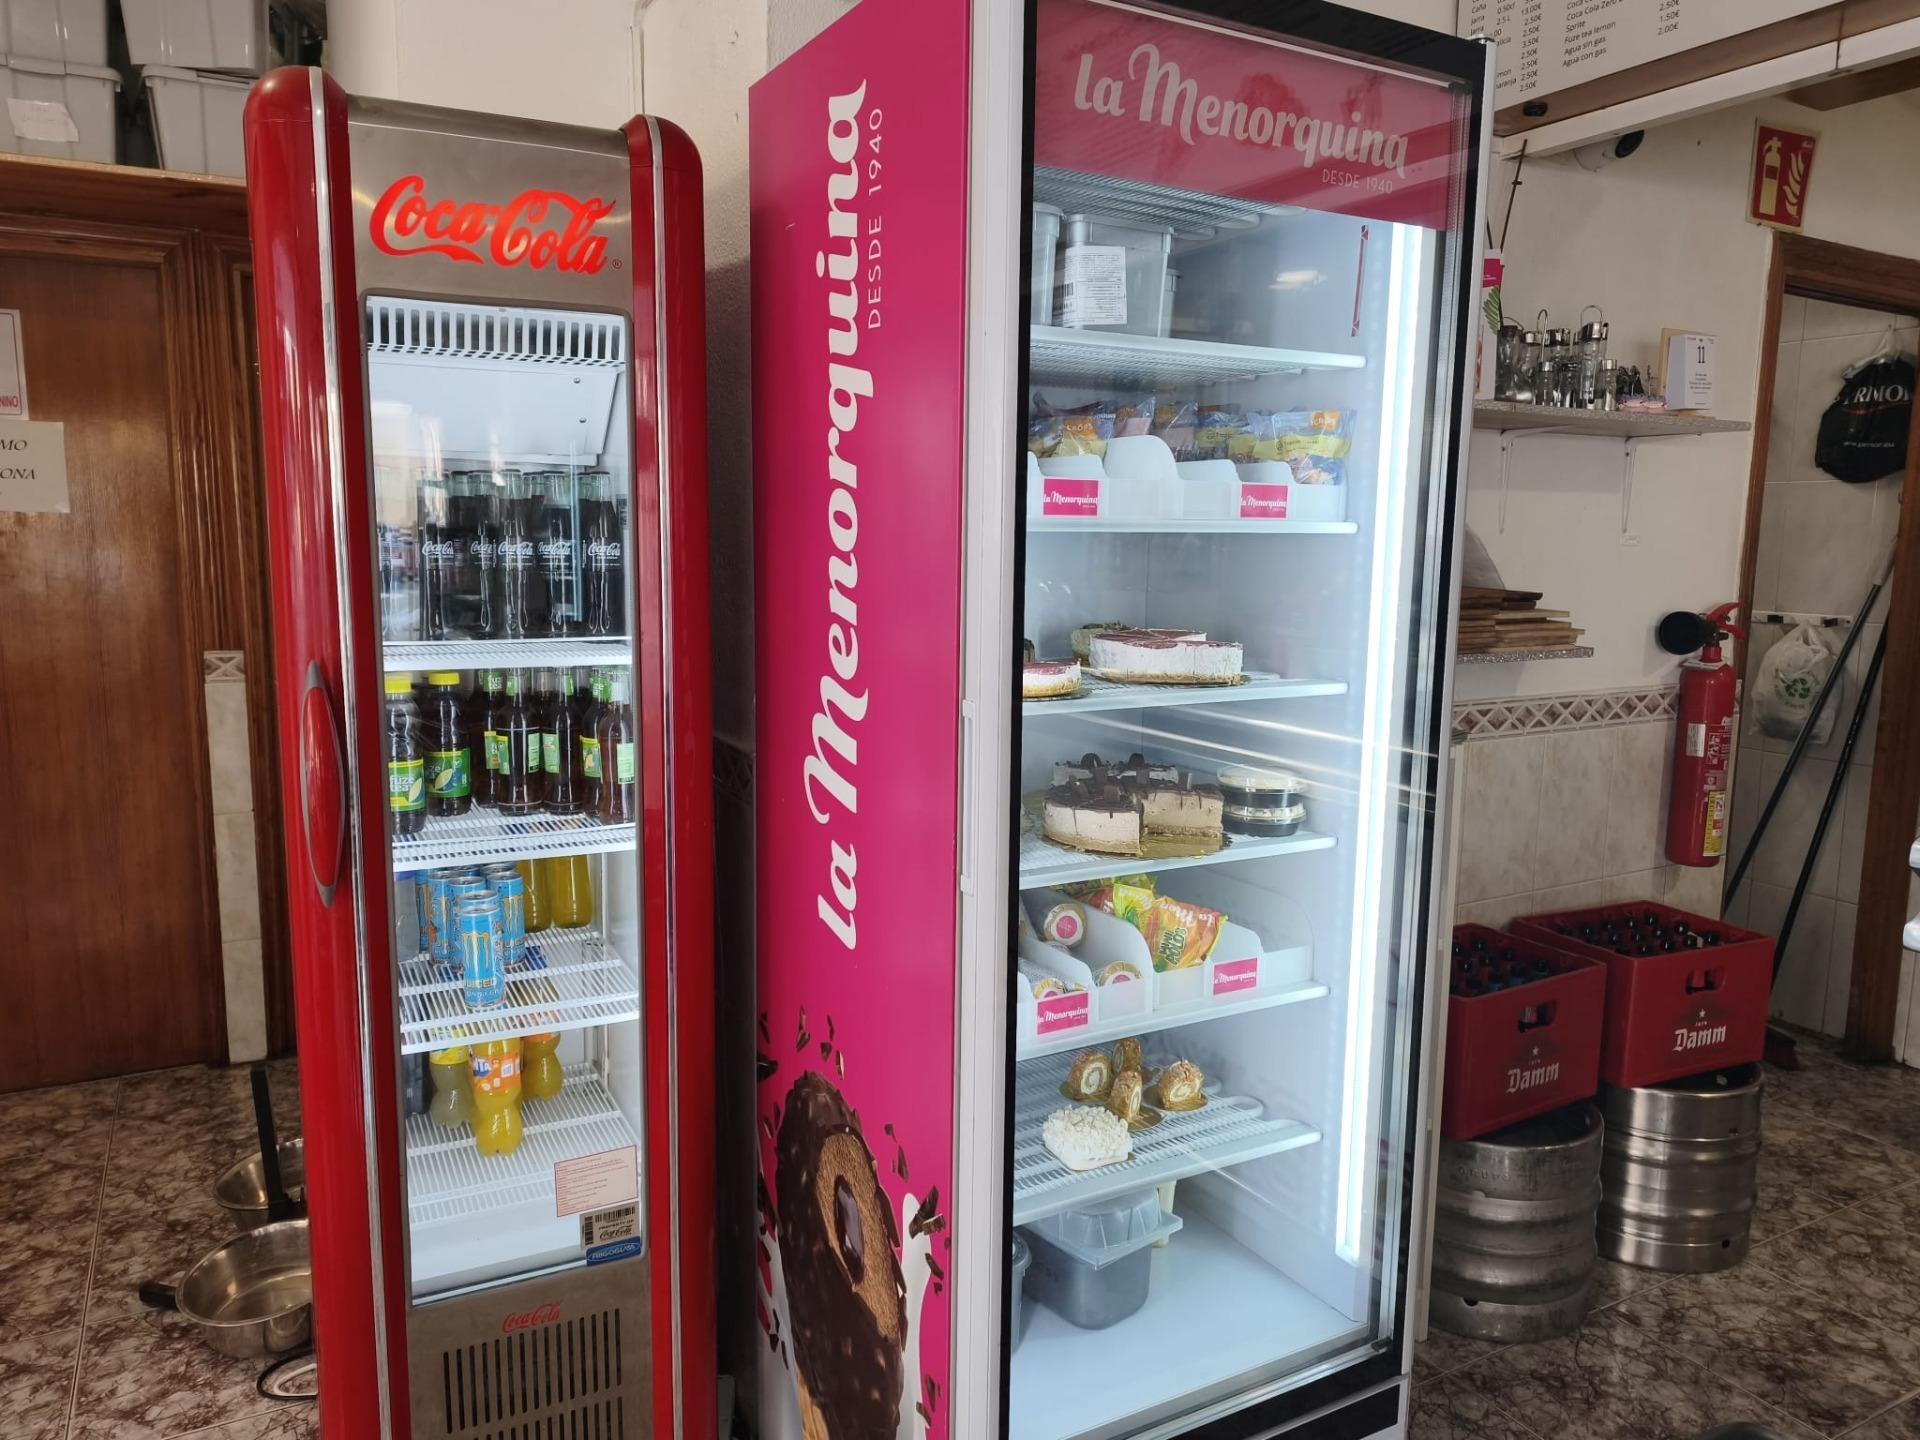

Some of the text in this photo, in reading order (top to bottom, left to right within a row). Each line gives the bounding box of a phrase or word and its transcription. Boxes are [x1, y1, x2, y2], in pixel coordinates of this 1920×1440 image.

[1566, 11, 1583, 21] Coca
[1584, 4, 1600, 15] Cola
[1566, 21, 1586, 33] Sprite
[1581, 30, 1593, 39] tea
[1594, 21, 1616, 34] lemon
[1563, 47, 1607, 67] Agua con gas
[1564, 36, 1606, 56] Agua sin gas
[1074, 43, 1408, 178] la Menorquina
[1322, 167, 1393, 195] DESDE 1940
[369, 175, 616, 275] Coca-Cola
[867, 108, 884, 329] DESDE 1940
[1697, 345, 1705, 364] 11
[803, 78, 874, 950] la Menorquina
[1672, 1025, 1727, 1052] Damm
[1505, 1061, 1560, 1094] Damm
[502, 1303, 561, 1333] Coca-Cola
